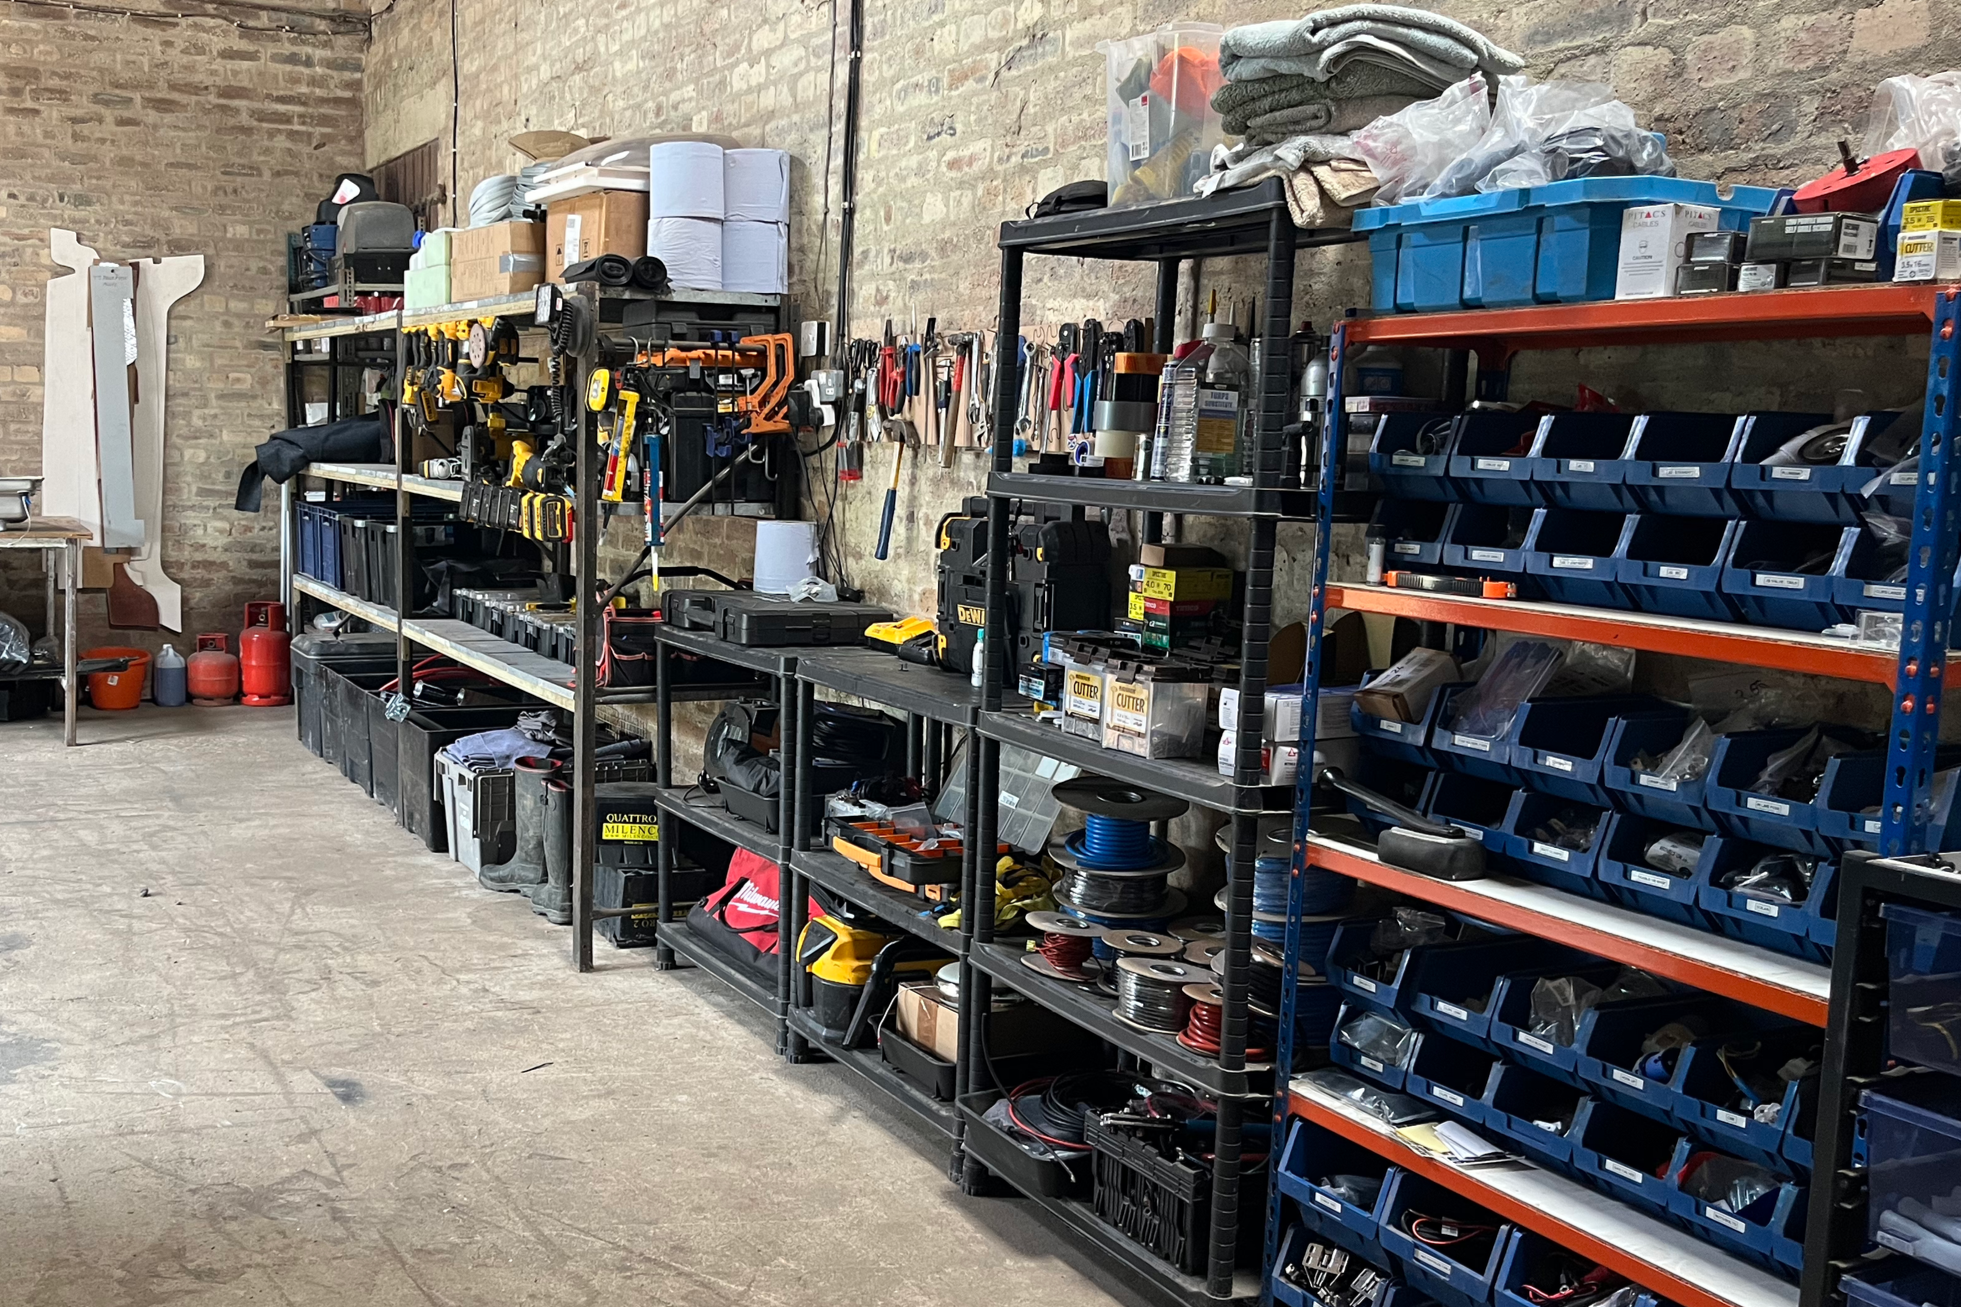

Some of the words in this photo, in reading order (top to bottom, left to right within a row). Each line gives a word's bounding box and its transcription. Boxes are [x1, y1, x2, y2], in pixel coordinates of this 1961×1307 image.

[1905, 242, 1935, 254] CUTTER
[959, 606, 985, 625] DEW
[1073, 680, 1099, 700] CUTTER
[1116, 692, 1146, 713] CUTTER
[605, 813, 657, 824] QUATTRO
[605, 825, 660, 835] MILENC
